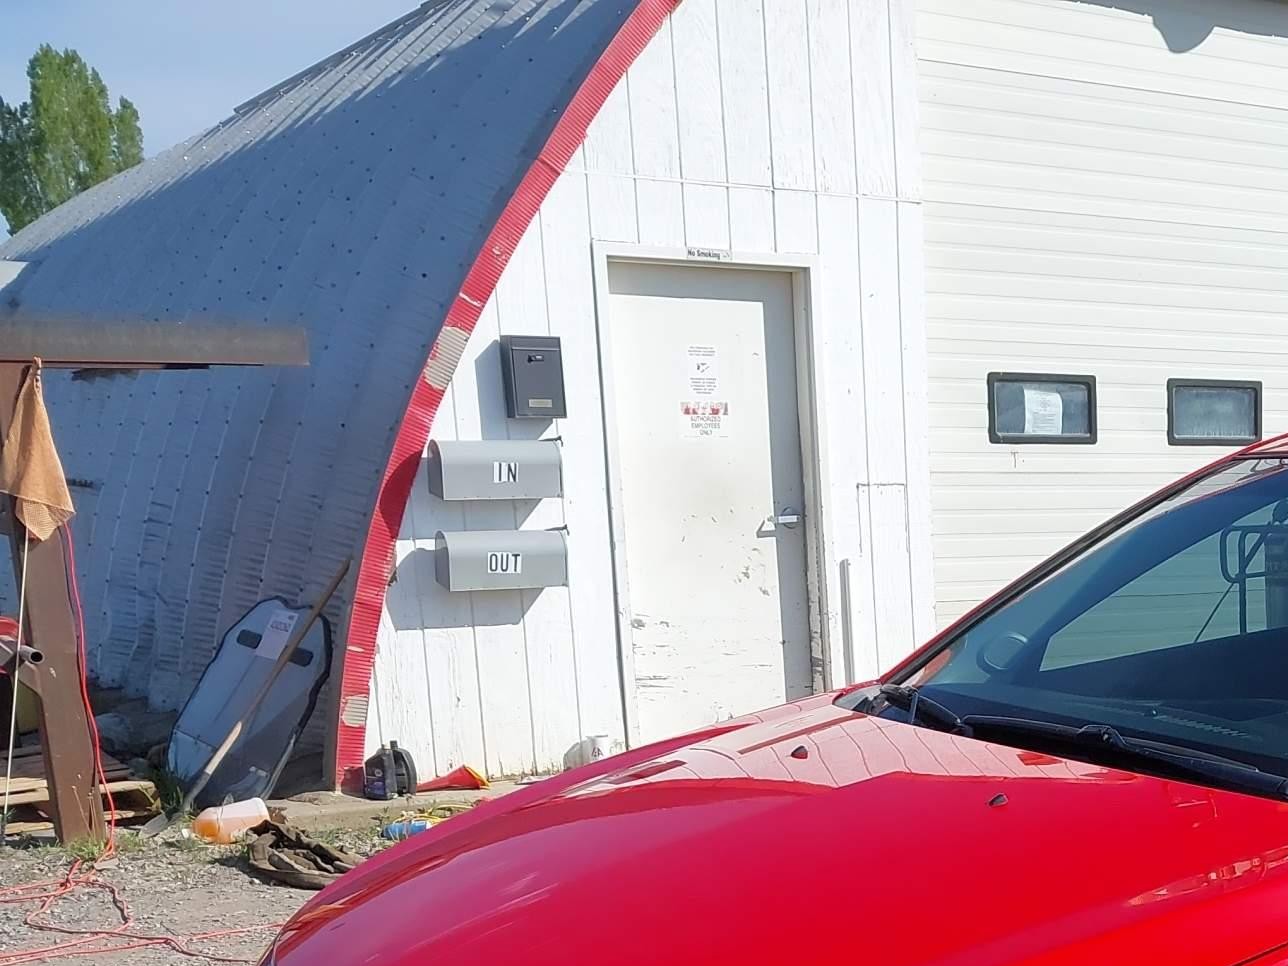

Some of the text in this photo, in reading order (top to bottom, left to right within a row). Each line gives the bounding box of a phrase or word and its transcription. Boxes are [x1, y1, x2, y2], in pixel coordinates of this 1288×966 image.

[697, 249, 720, 260] Smoking
[498, 462, 517, 482] IN
[489, 553, 521, 572] OUT
